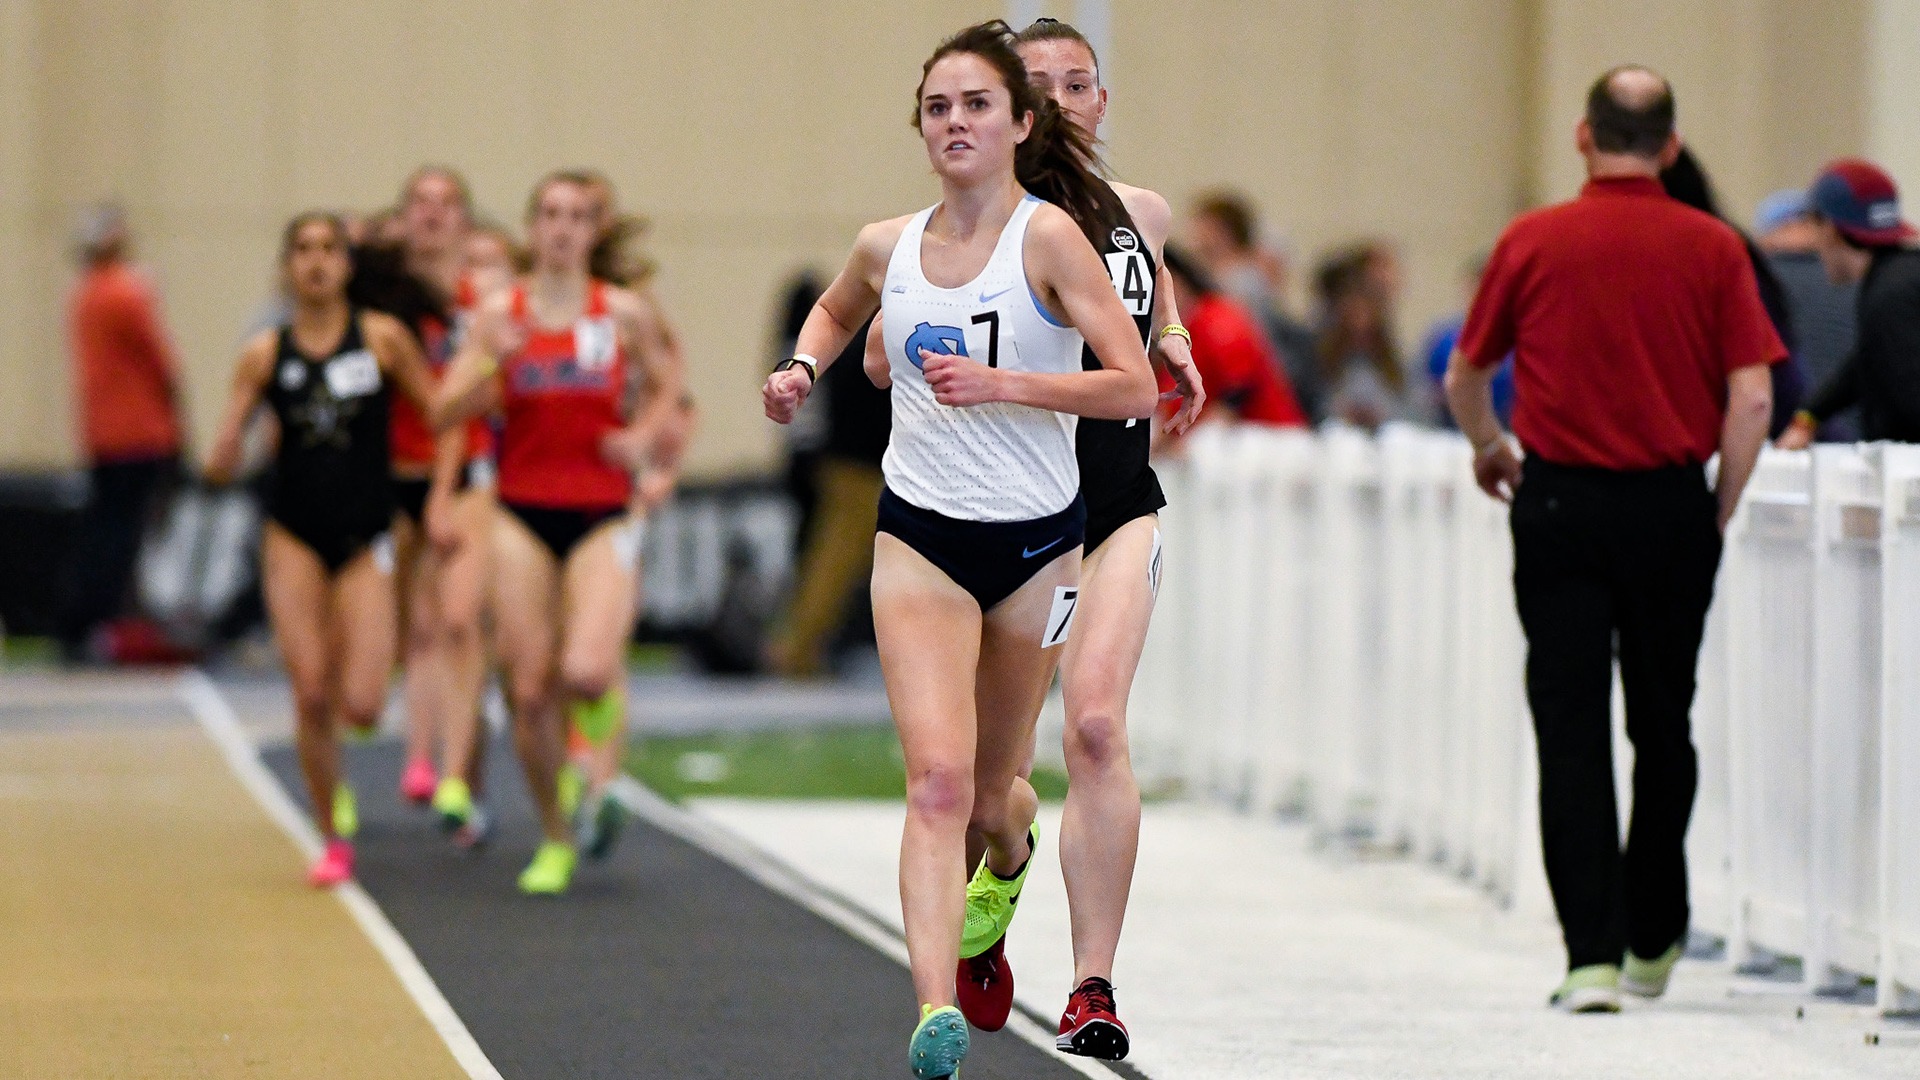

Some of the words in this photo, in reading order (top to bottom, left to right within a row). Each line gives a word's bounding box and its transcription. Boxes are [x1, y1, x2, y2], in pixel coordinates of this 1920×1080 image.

[1123, 256, 1147, 311] 4
[971, 310, 999, 368] 7
[1050, 591, 1078, 642] 7
